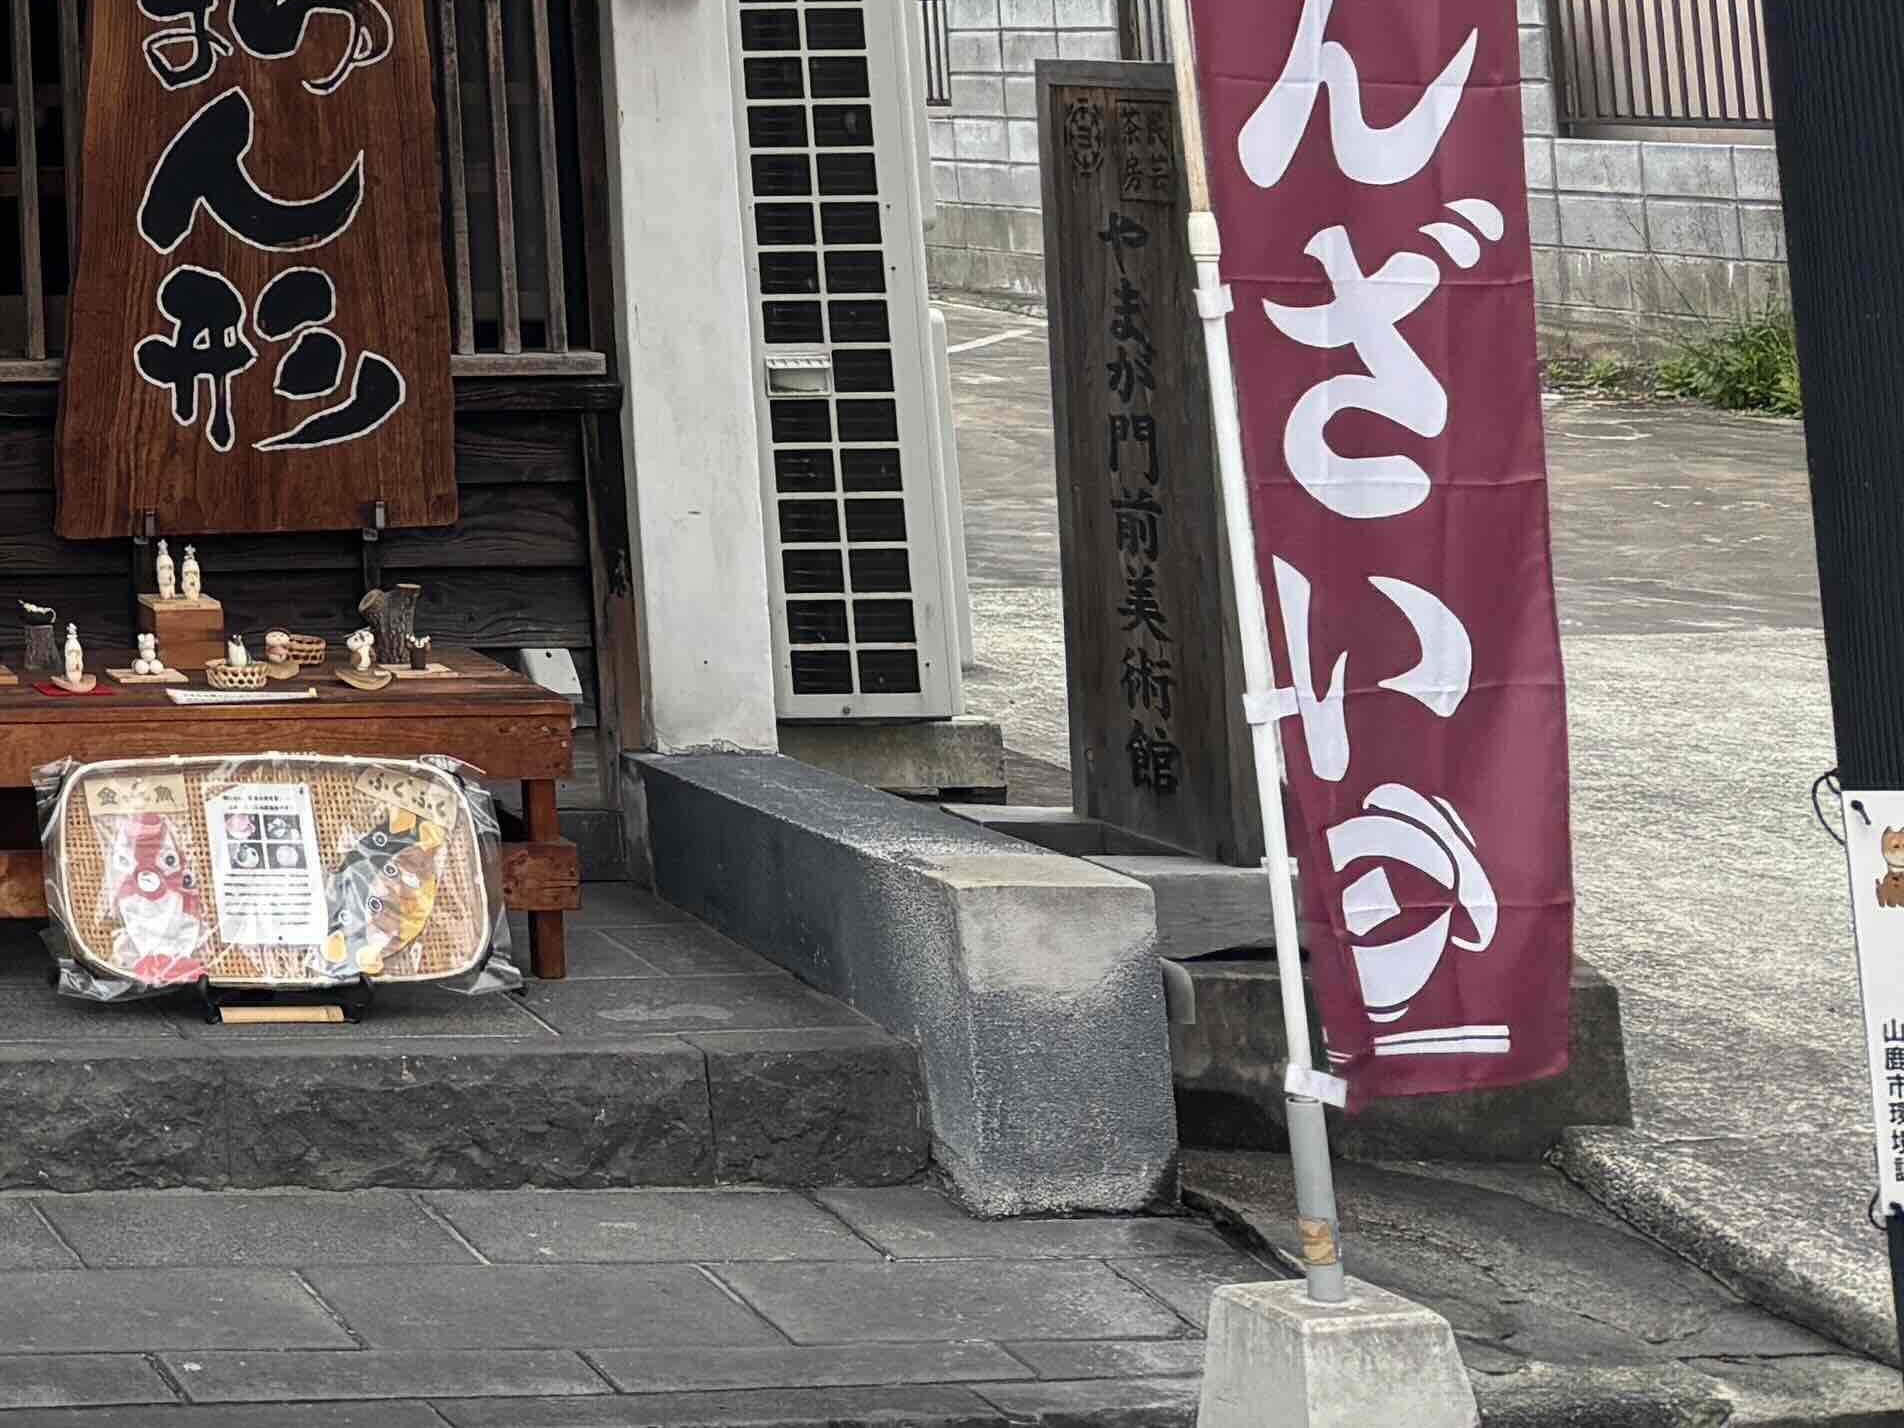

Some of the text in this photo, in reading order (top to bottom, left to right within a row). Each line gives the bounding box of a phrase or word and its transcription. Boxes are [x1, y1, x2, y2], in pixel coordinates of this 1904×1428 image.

[1097, 211, 1181, 800] やまが門前美術館
